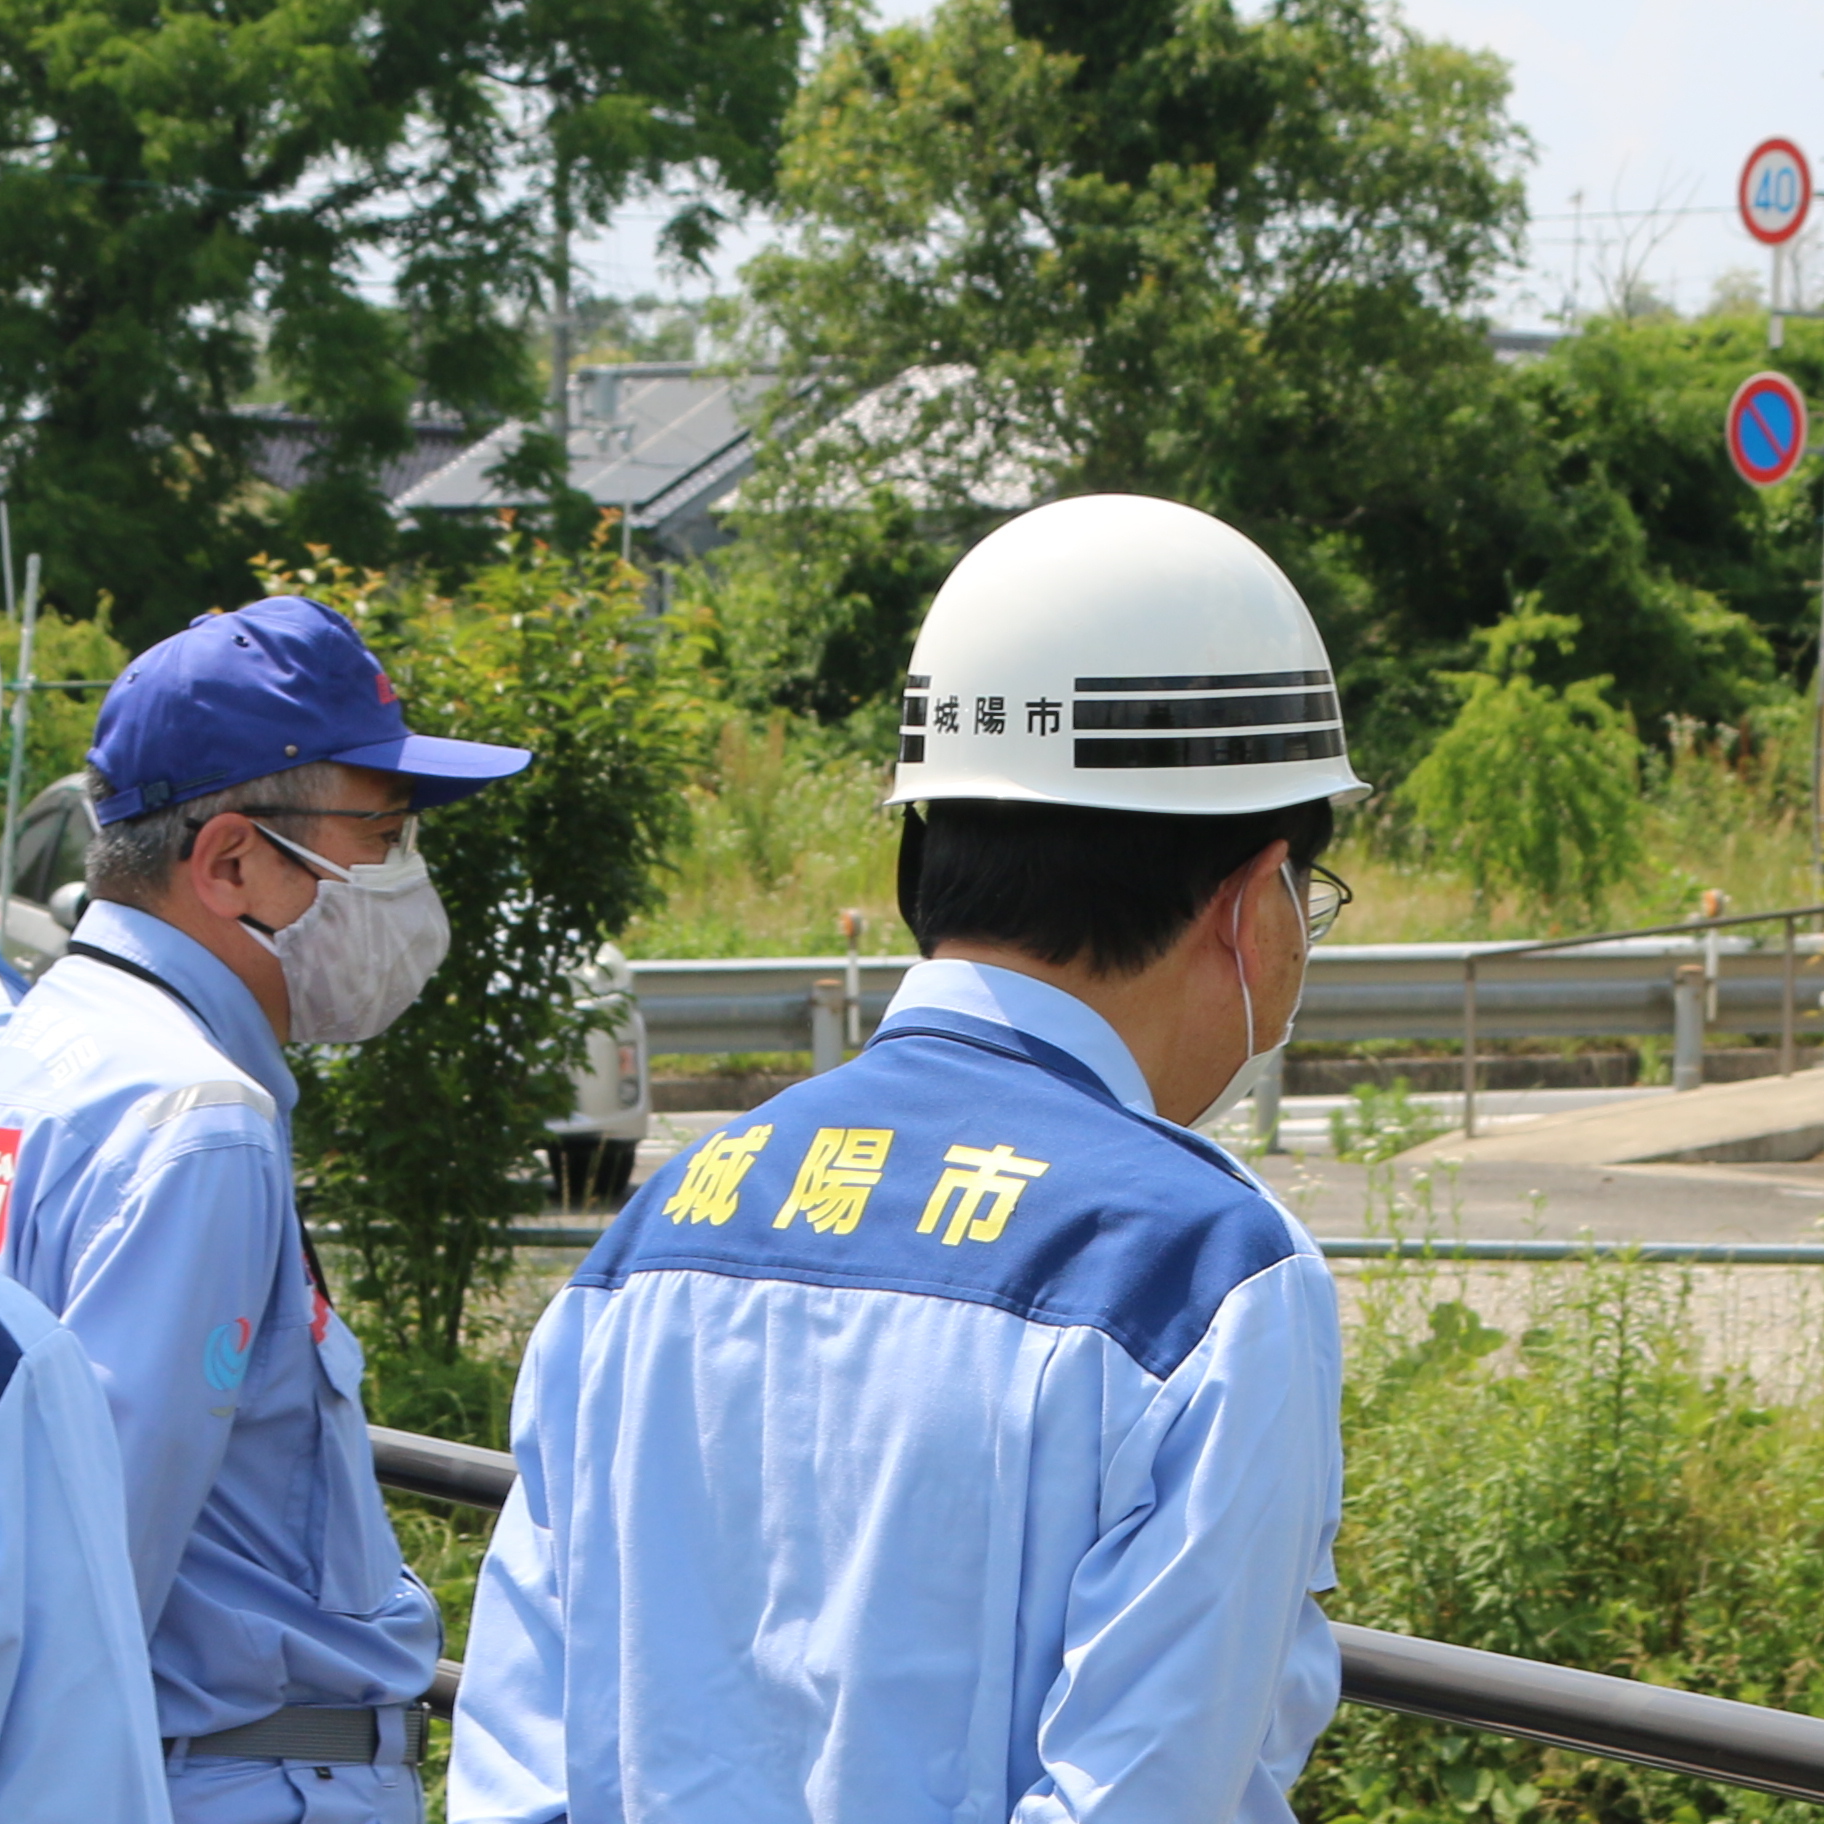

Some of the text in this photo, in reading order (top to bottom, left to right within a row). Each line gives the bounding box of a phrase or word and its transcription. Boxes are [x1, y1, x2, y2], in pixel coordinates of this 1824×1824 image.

[1754, 167, 1796, 213] 40
[933, 695, 1063, 737] 城陽市
[663, 1123, 1051, 1247] 城陽市
